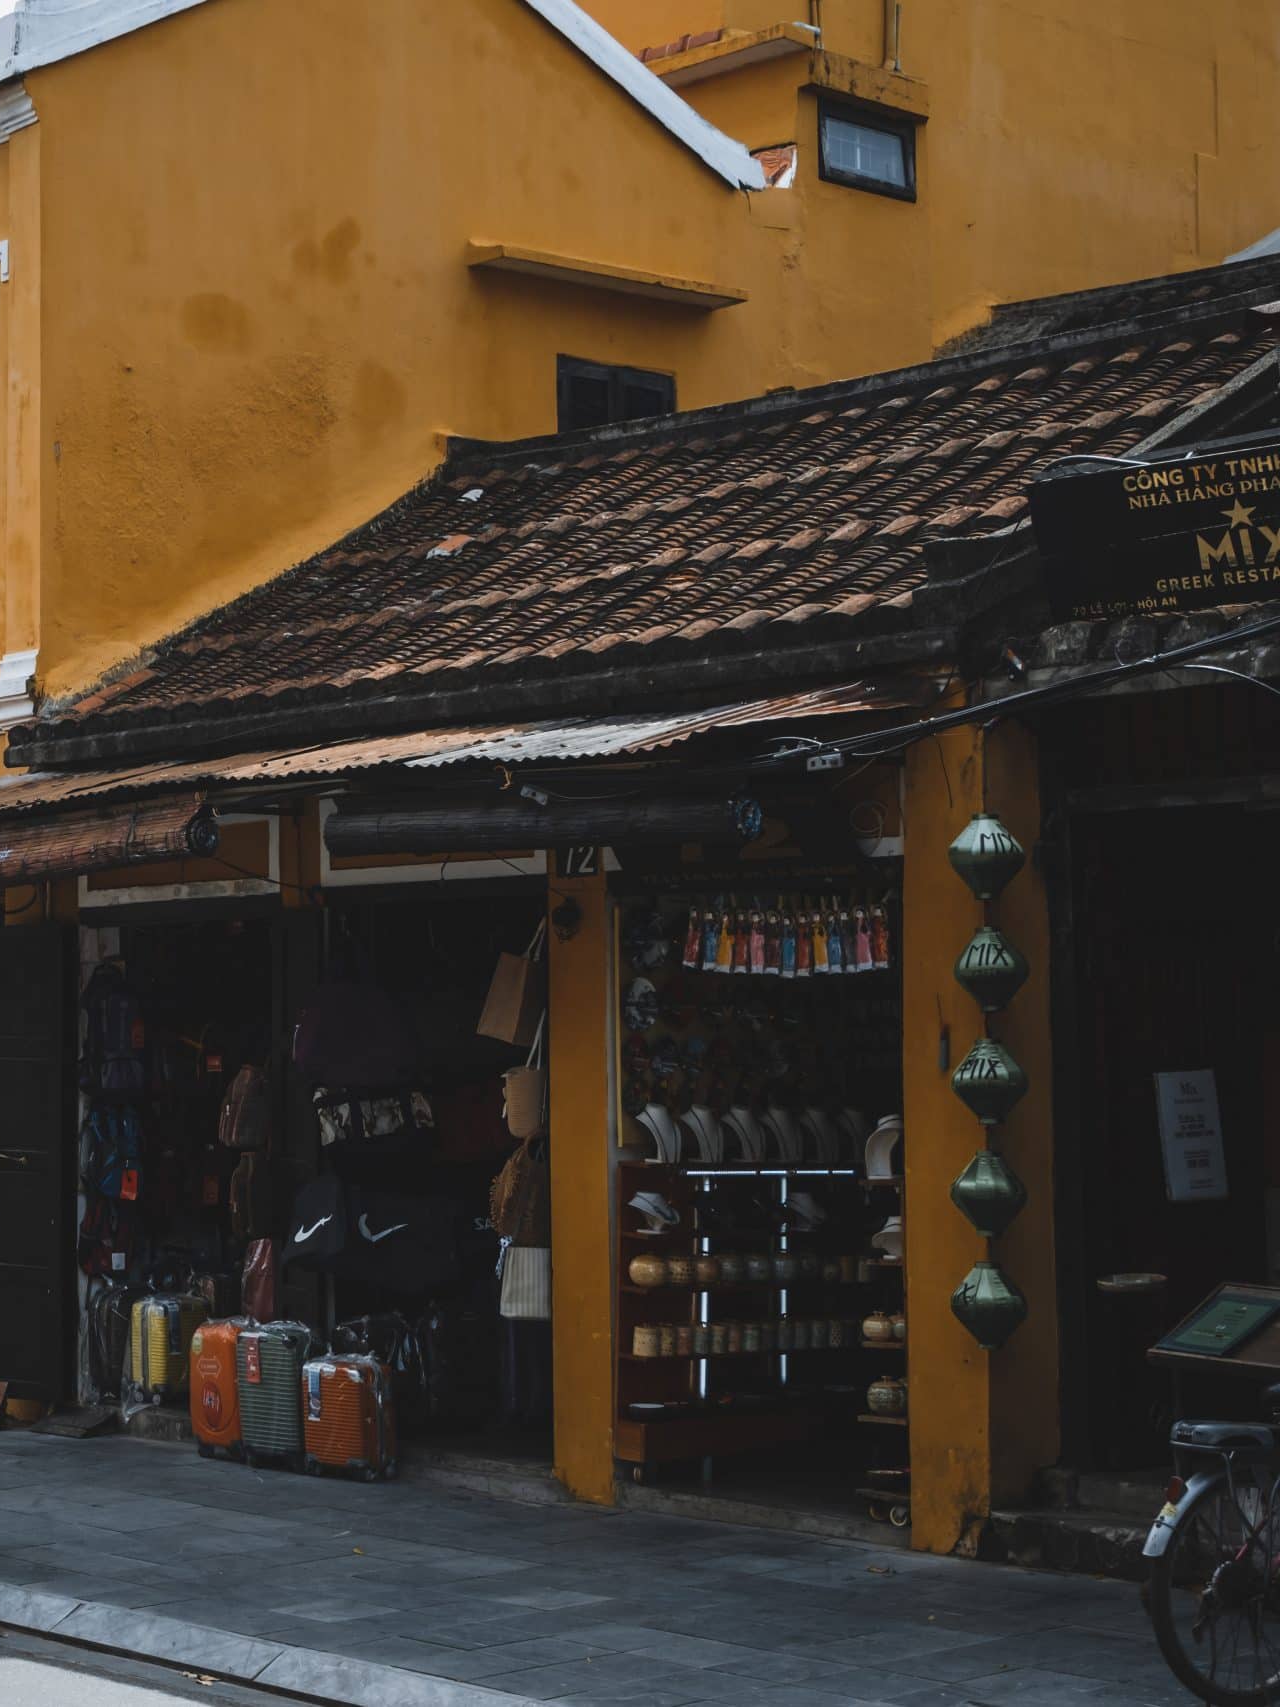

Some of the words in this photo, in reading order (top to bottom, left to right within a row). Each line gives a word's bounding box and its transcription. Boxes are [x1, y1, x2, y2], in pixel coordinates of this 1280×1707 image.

[1122, 469, 1184, 492] CÔNG
[1188, 463, 1217, 481] TY
[1156, 574, 1215, 592] GREEK
[1137, 595, 1157, 611] HỘI
[980, 832, 1021, 855] MIX
[565, 846, 594, 874] 12
[965, 943, 1009, 969] MIX
